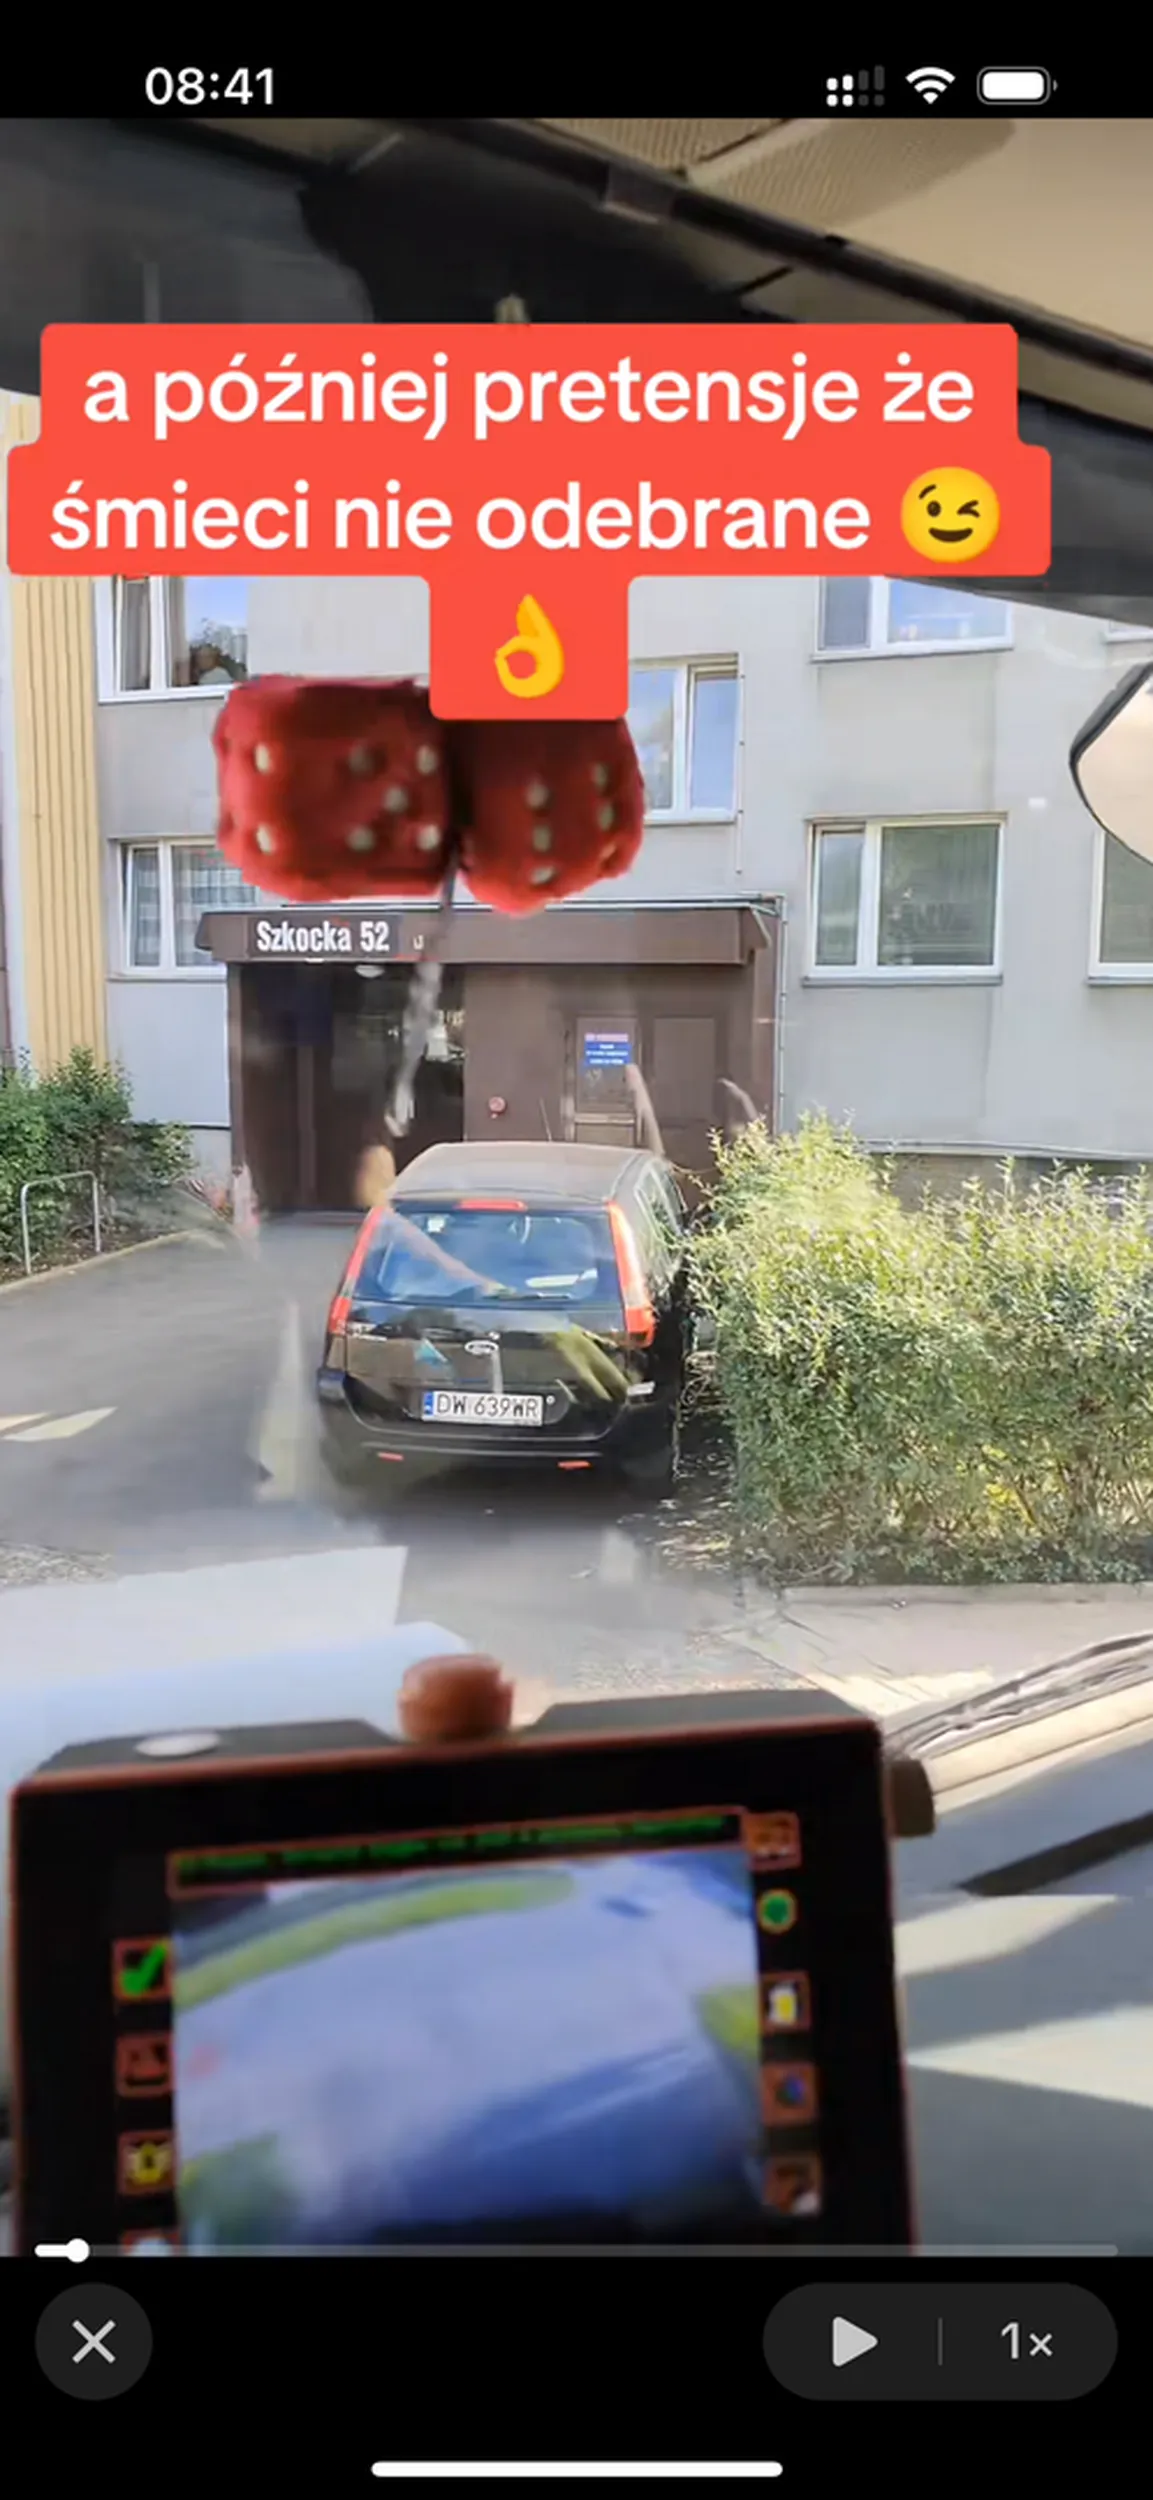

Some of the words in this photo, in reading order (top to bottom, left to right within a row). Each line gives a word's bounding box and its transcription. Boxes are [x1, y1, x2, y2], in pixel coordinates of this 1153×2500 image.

[257, 920, 352, 952] Szkocka
[360, 920, 389, 952] 52
[436, 1393, 468, 1415] DW
[474, 1396, 539, 1418] 639WR
